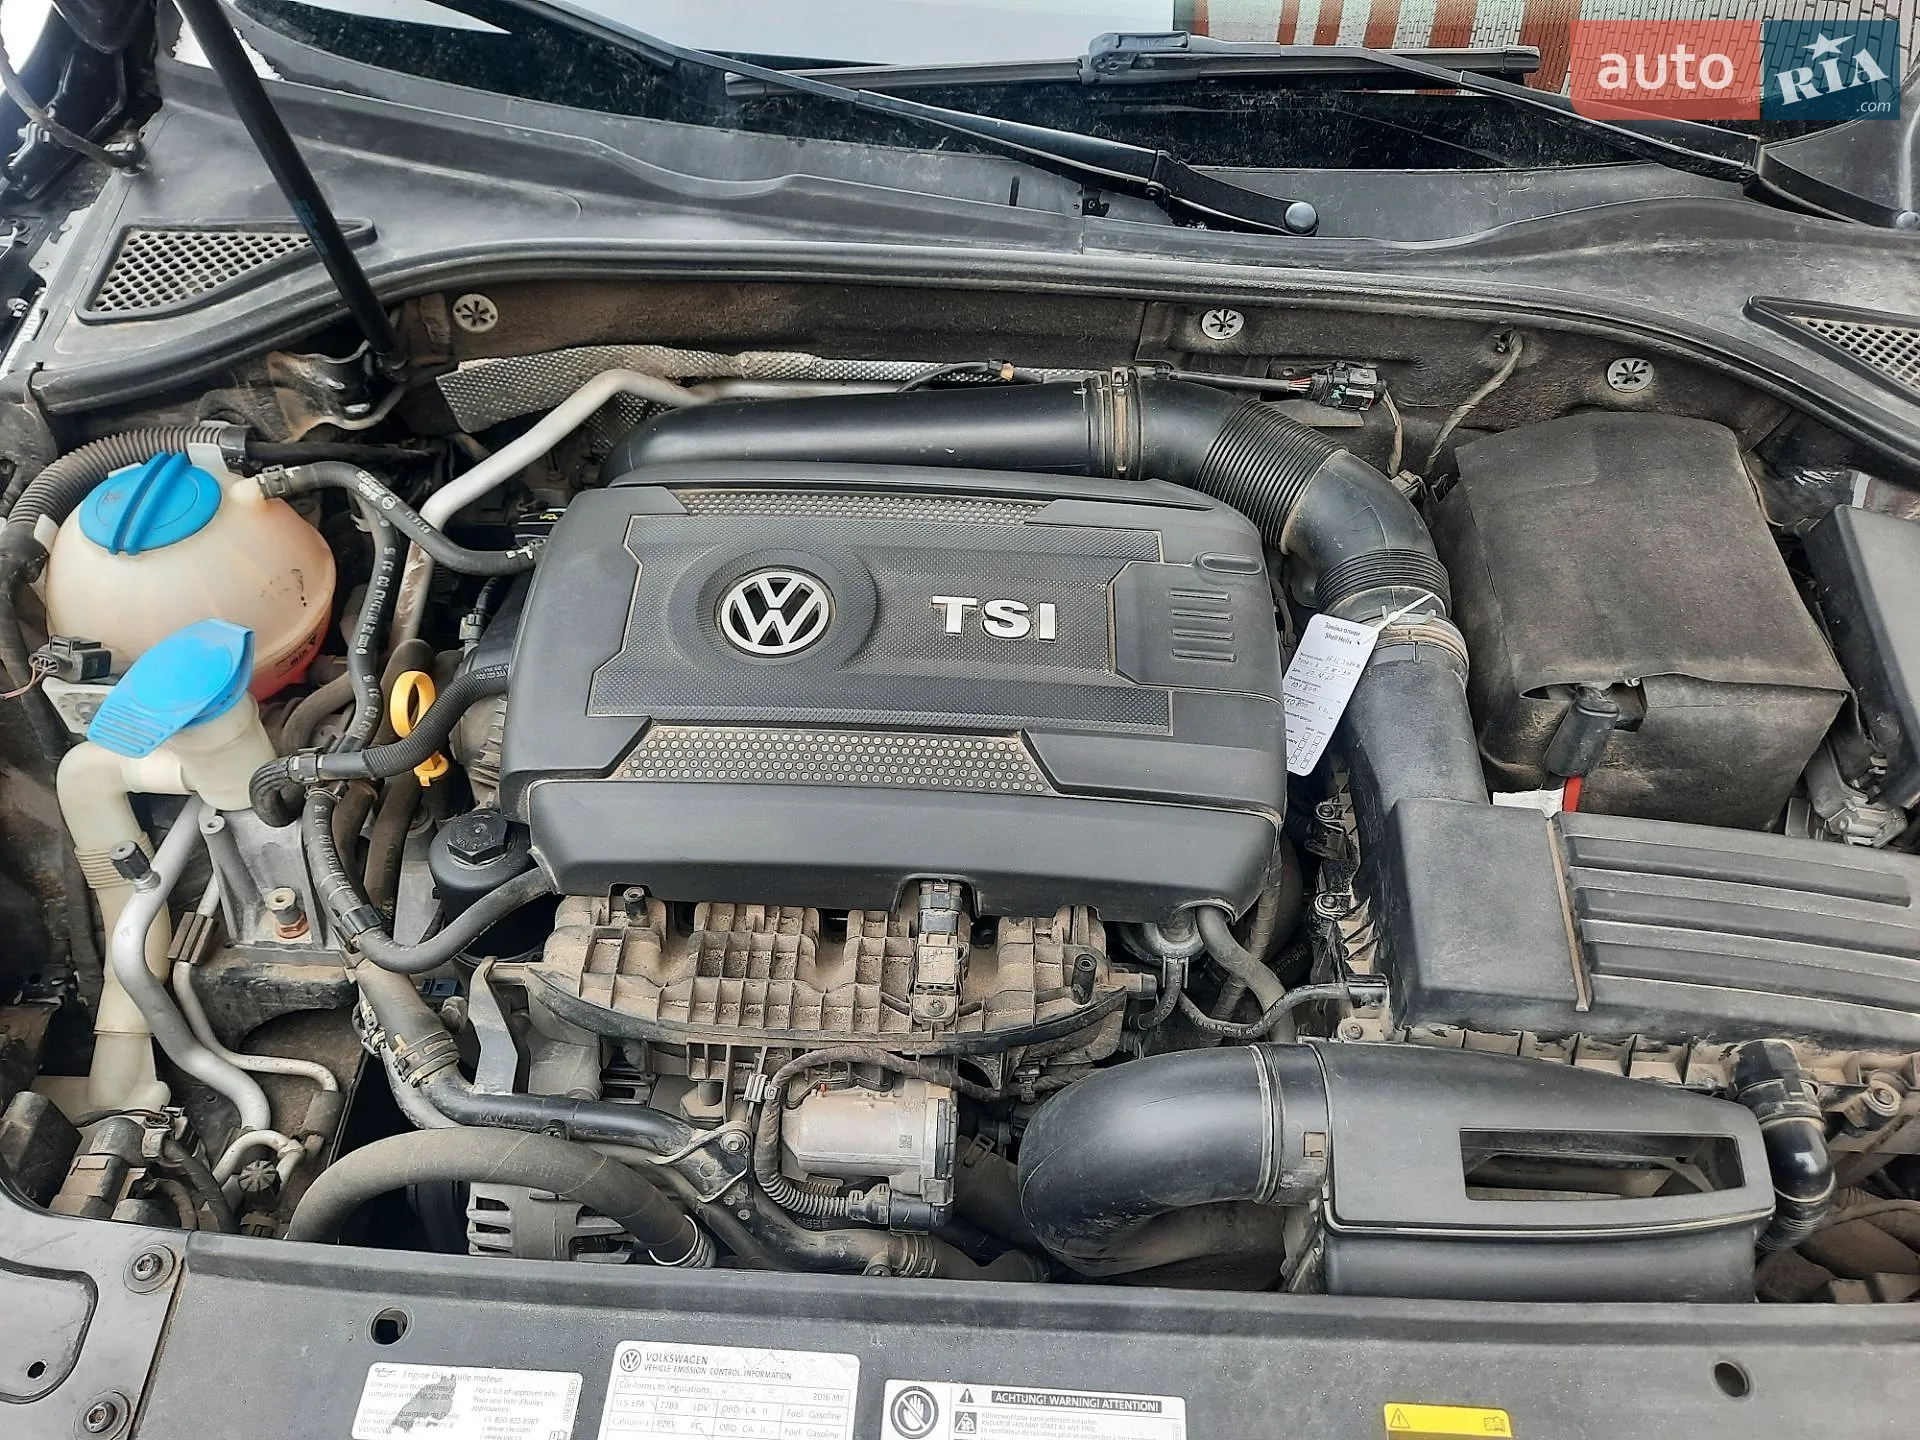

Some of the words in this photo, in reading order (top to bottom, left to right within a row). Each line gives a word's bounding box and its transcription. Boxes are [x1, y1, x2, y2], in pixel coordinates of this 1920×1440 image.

[931, 595, 1057, 643] TSI
[646, 1352, 709, 1365] VOLKSWAGEN
[644, 1363, 671, 1373] VEHICLE
[673, 1365, 706, 1375] EMISSION
[709, 1368, 740, 1377] CONTROL
[743, 1369, 792, 1380] INFORMATION
[813, 1392, 831, 1401] 2016
[995, 1392, 1047, 1405] ACHTUNG!
[1049, 1396, 1100, 1409] WARNING!
[1102, 1399, 1159, 1412] ATTENTION!
[808, 1410, 842, 1420] Gasoline
[806, 1429, 840, 1439] Gasoline
